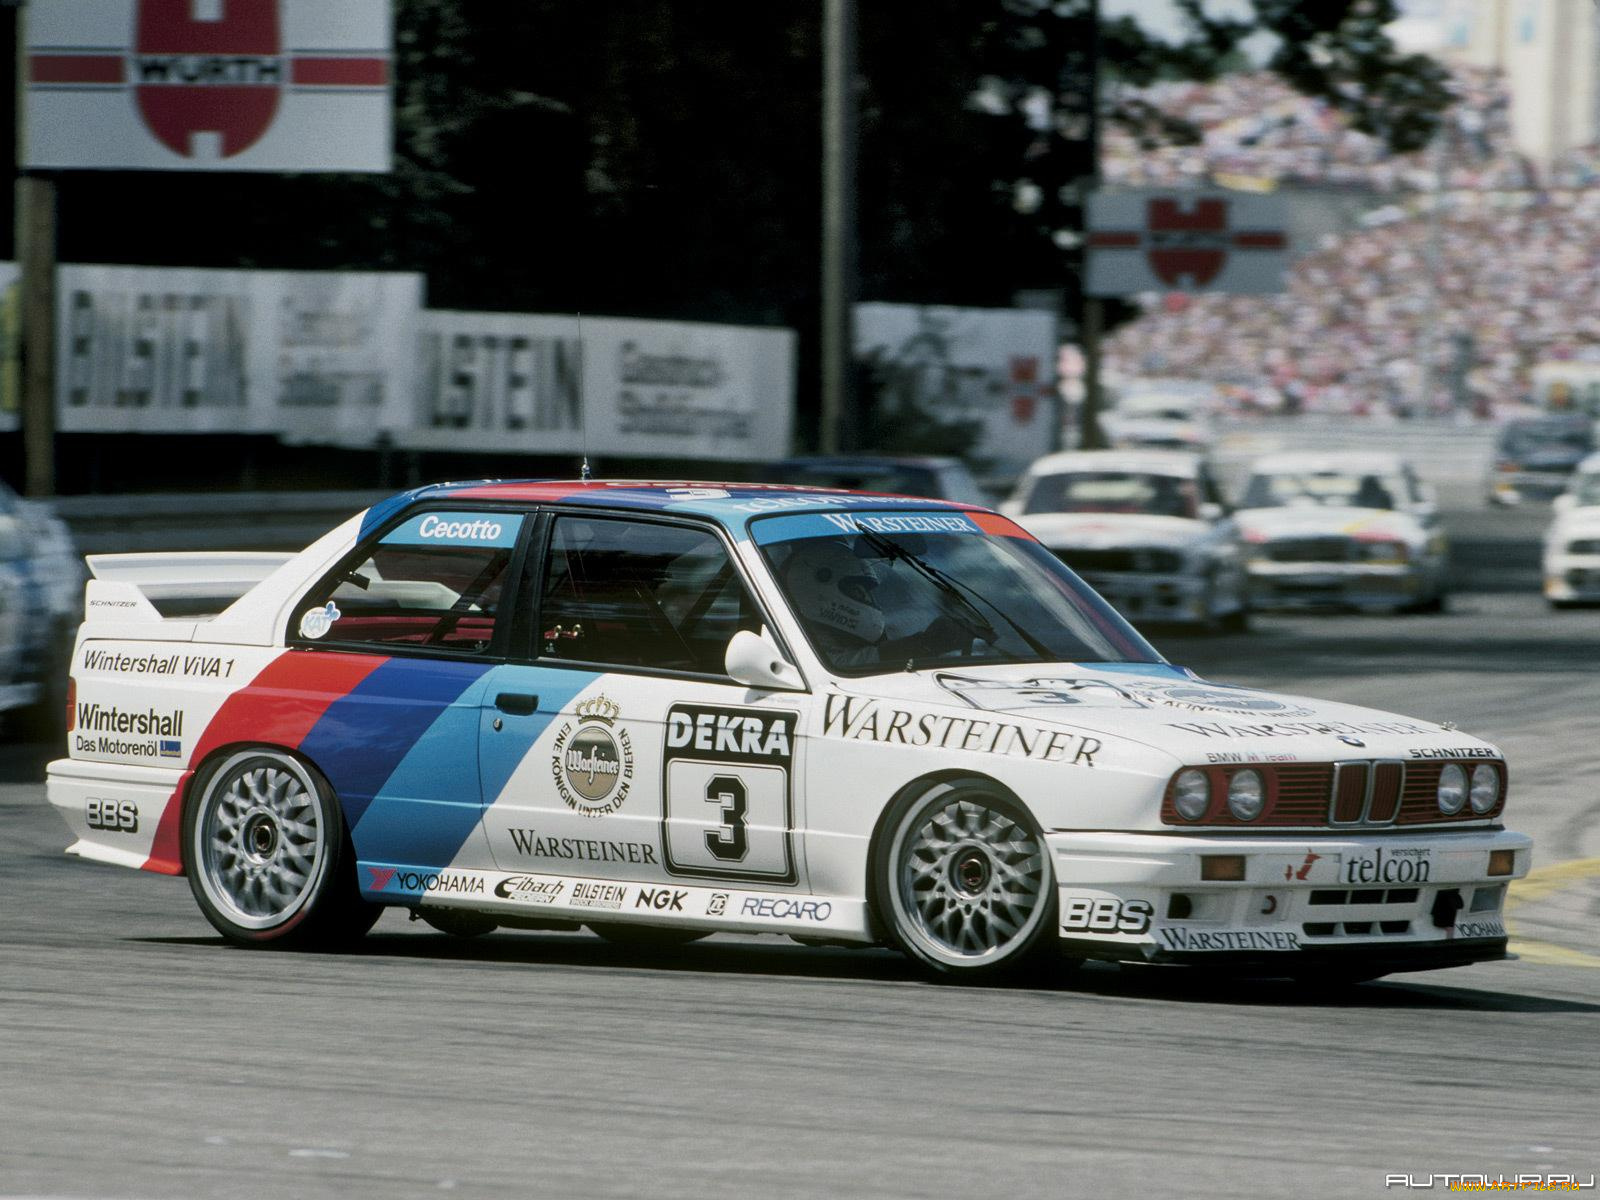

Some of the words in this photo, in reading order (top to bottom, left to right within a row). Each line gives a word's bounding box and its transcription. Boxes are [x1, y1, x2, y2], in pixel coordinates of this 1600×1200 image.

[420, 515, 501, 540] Cecotto
[821, 512, 976, 534] WARSTEINER
[89, 599, 137, 607] SCHNITZER
[84, 650, 180, 675] Wintershall
[225, 659, 234, 678] 1
[78, 703, 184, 737] Wintershall
[823, 692, 1103, 768] WARSTEINER
[76, 735, 96, 752] Das
[99, 736, 158, 757] Motorenöl
[553, 722, 572, 754] EINE
[667, 712, 790, 756] DEKRA
[618, 728, 634, 779] BIEREN
[1206, 751, 1242, 762] BMW
[1408, 748, 1496, 758] SCHNITZER
[552, 755, 577, 810] KÖNIGIN
[612, 782, 630, 809] DEN
[86, 797, 139, 834] BBS
[704, 773, 749, 863] 3
[507, 828, 659, 866] WARSTEINER
[1347, 847, 1430, 883] telcon
[396, 872, 484, 893] YOKOHAMA
[494, 876, 565, 900] Eibach
[572, 883, 627, 901] BILSTEIN
[635, 888, 688, 912] NGK
[741, 897, 832, 921] RECARO
[1061, 897, 1154, 934] BBS
[1160, 927, 1301, 950] WARSTEINER
